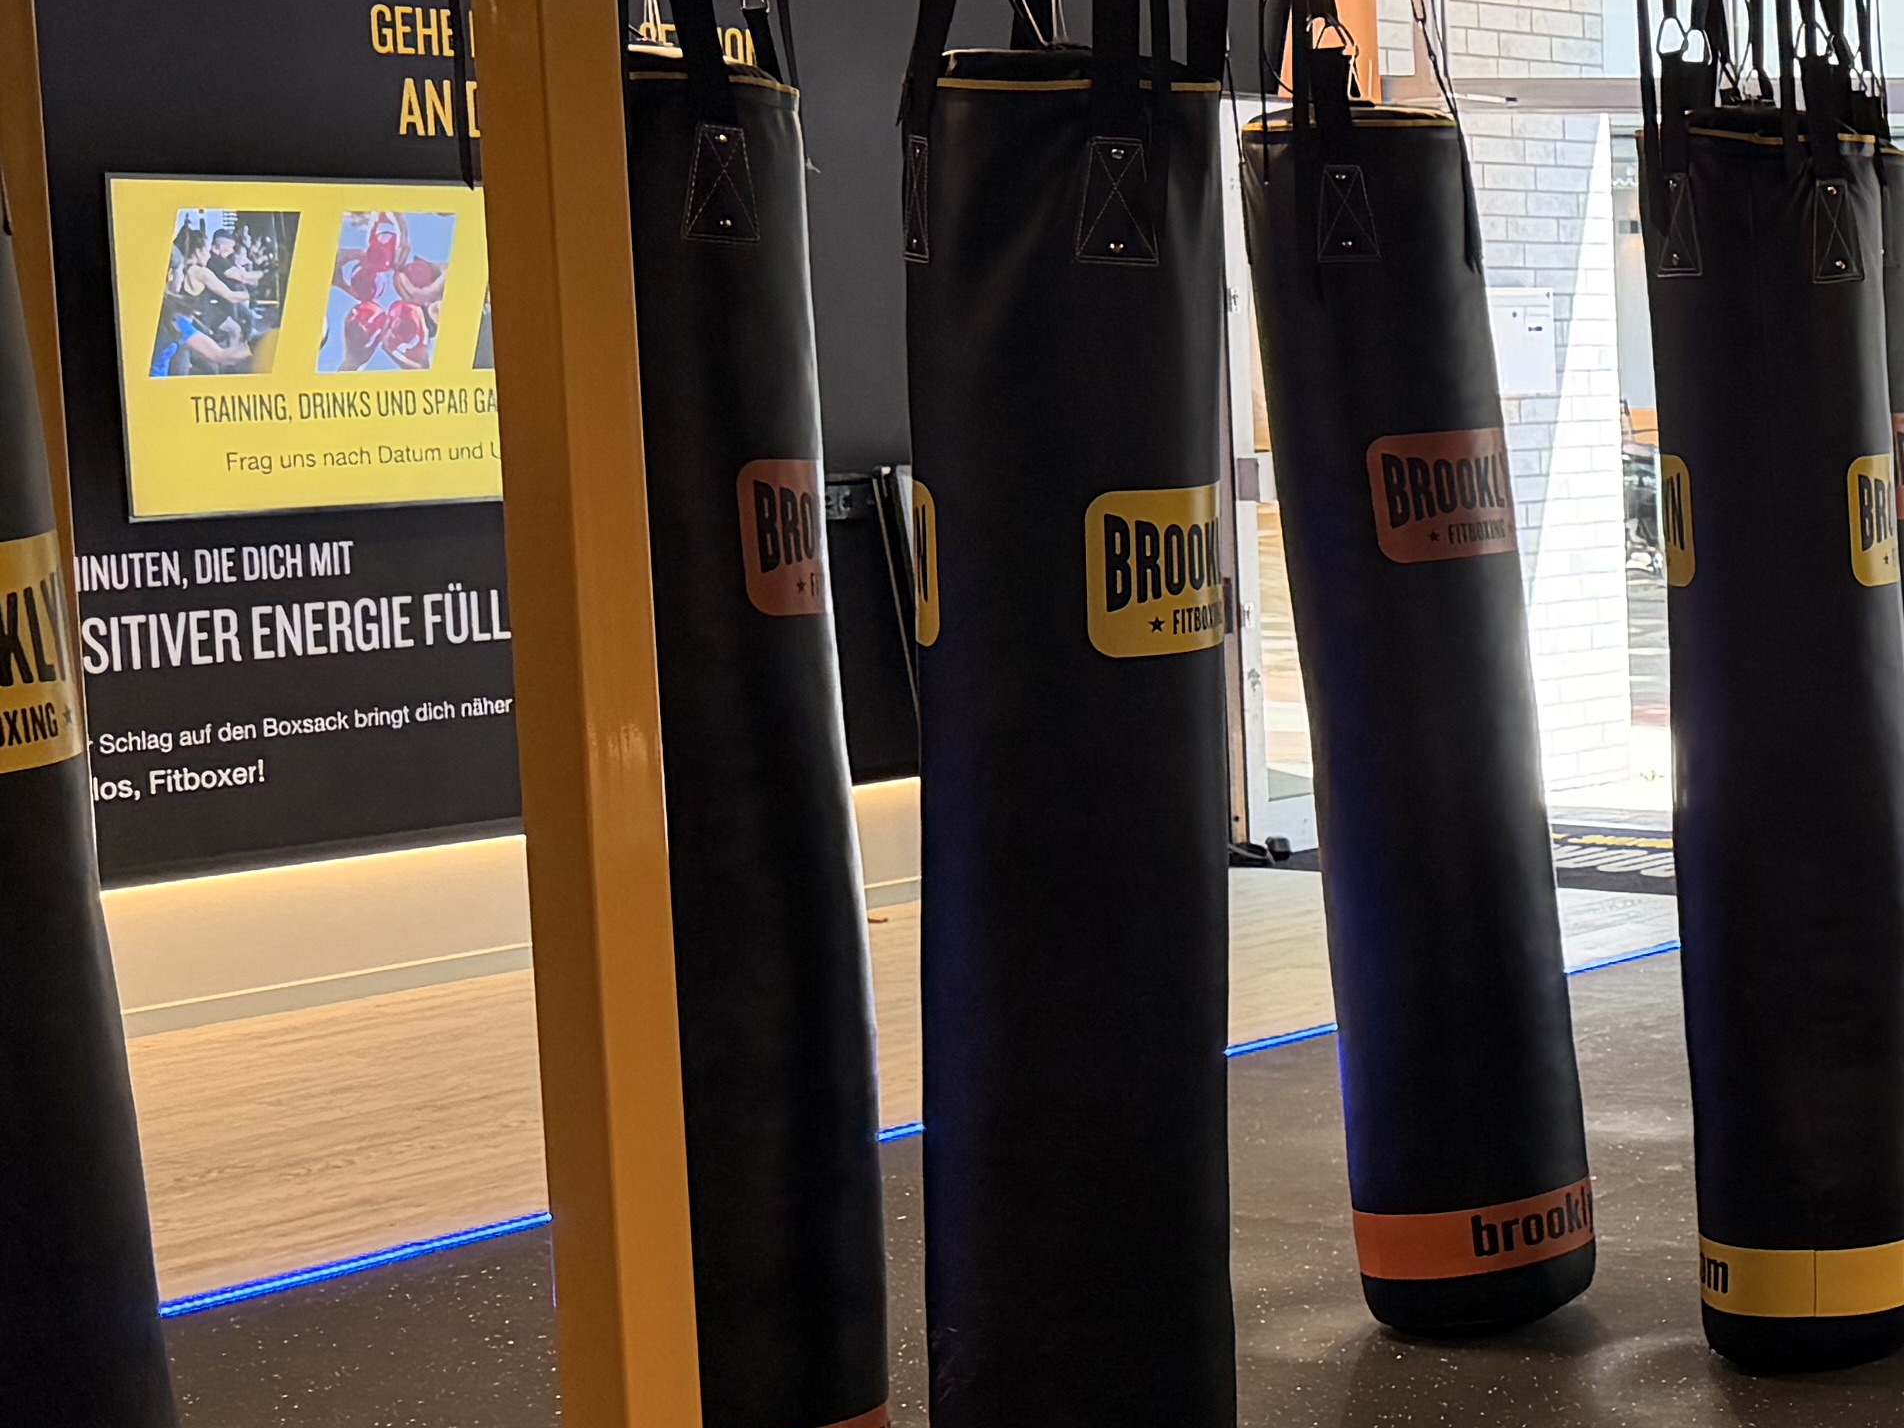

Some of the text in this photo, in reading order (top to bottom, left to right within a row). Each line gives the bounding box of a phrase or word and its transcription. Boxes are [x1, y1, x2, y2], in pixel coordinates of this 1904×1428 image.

[190, 392, 293, 425] TRAINING,
[299, 389, 372, 420] DRINKS
[377, 388, 417, 417] UND
[226, 451, 273, 475] Frag
[279, 451, 317, 469] uns
[323, 446, 372, 467] nach
[378, 444, 442, 465] Datum
[448, 441, 483, 461] und
[194, 546, 237, 585] DIE
[243, 543, 302, 582] DICH
[309, 540, 354, 578] MIT
[81, 582, 513, 675] SITIVER ENERGIE FÜLL
[99, 728, 173, 754] Schlag
[179, 723, 212, 747] auf
[217, 721, 257, 743] den
[263, 710, 350, 739] Boxsack
[354, 705, 411, 731] bringt
[415, 701, 455, 723] dich
[461, 696, 514, 719] näher
[93, 758, 266, 802] los, Fitboxer!
